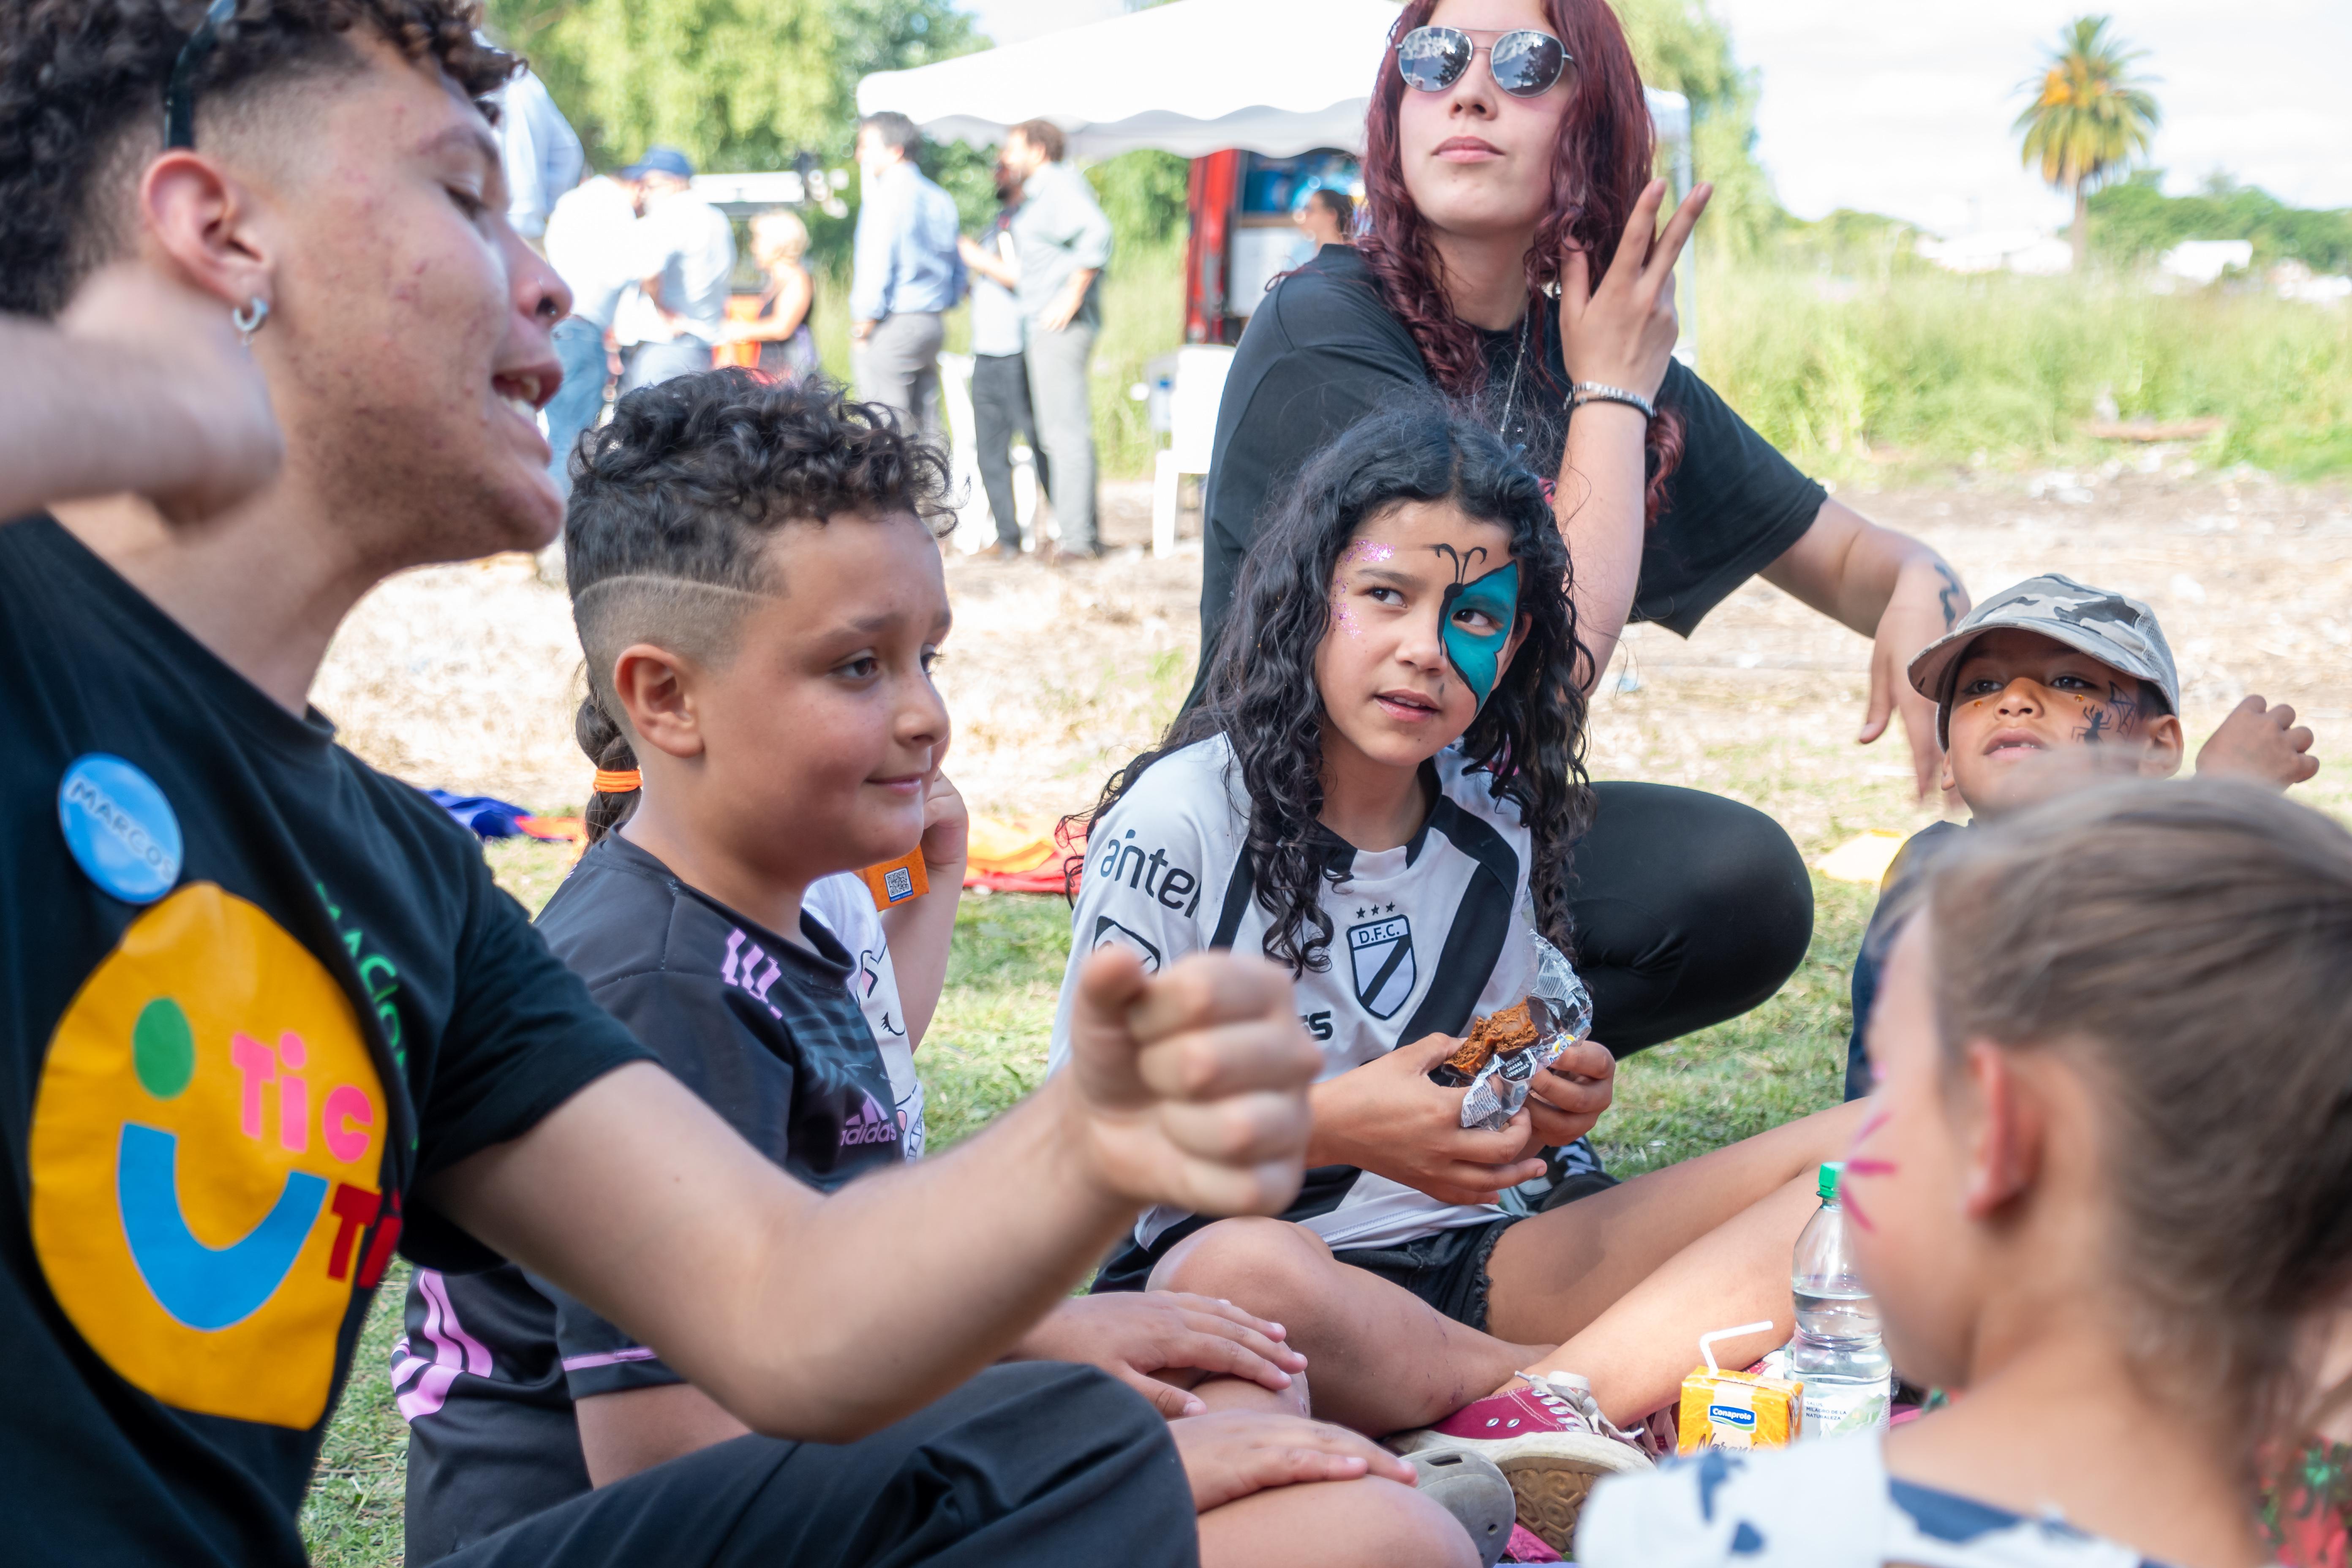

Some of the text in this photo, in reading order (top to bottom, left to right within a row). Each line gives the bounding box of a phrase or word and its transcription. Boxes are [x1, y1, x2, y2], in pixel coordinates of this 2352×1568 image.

[71, 781, 174, 881] MARCOS
[1101, 829, 1202, 918] antel
[1358, 924, 1400, 944] D.F.C.
[1505, 1056, 1520, 1067] EXCESO
[1506, 1061, 1523, 1072] GRASAS
[1506, 1063, 1529, 1078] SATURADAS
[233, 1031, 373, 1162] Tic
[1712, 1407, 1752, 1421] Conaprole
